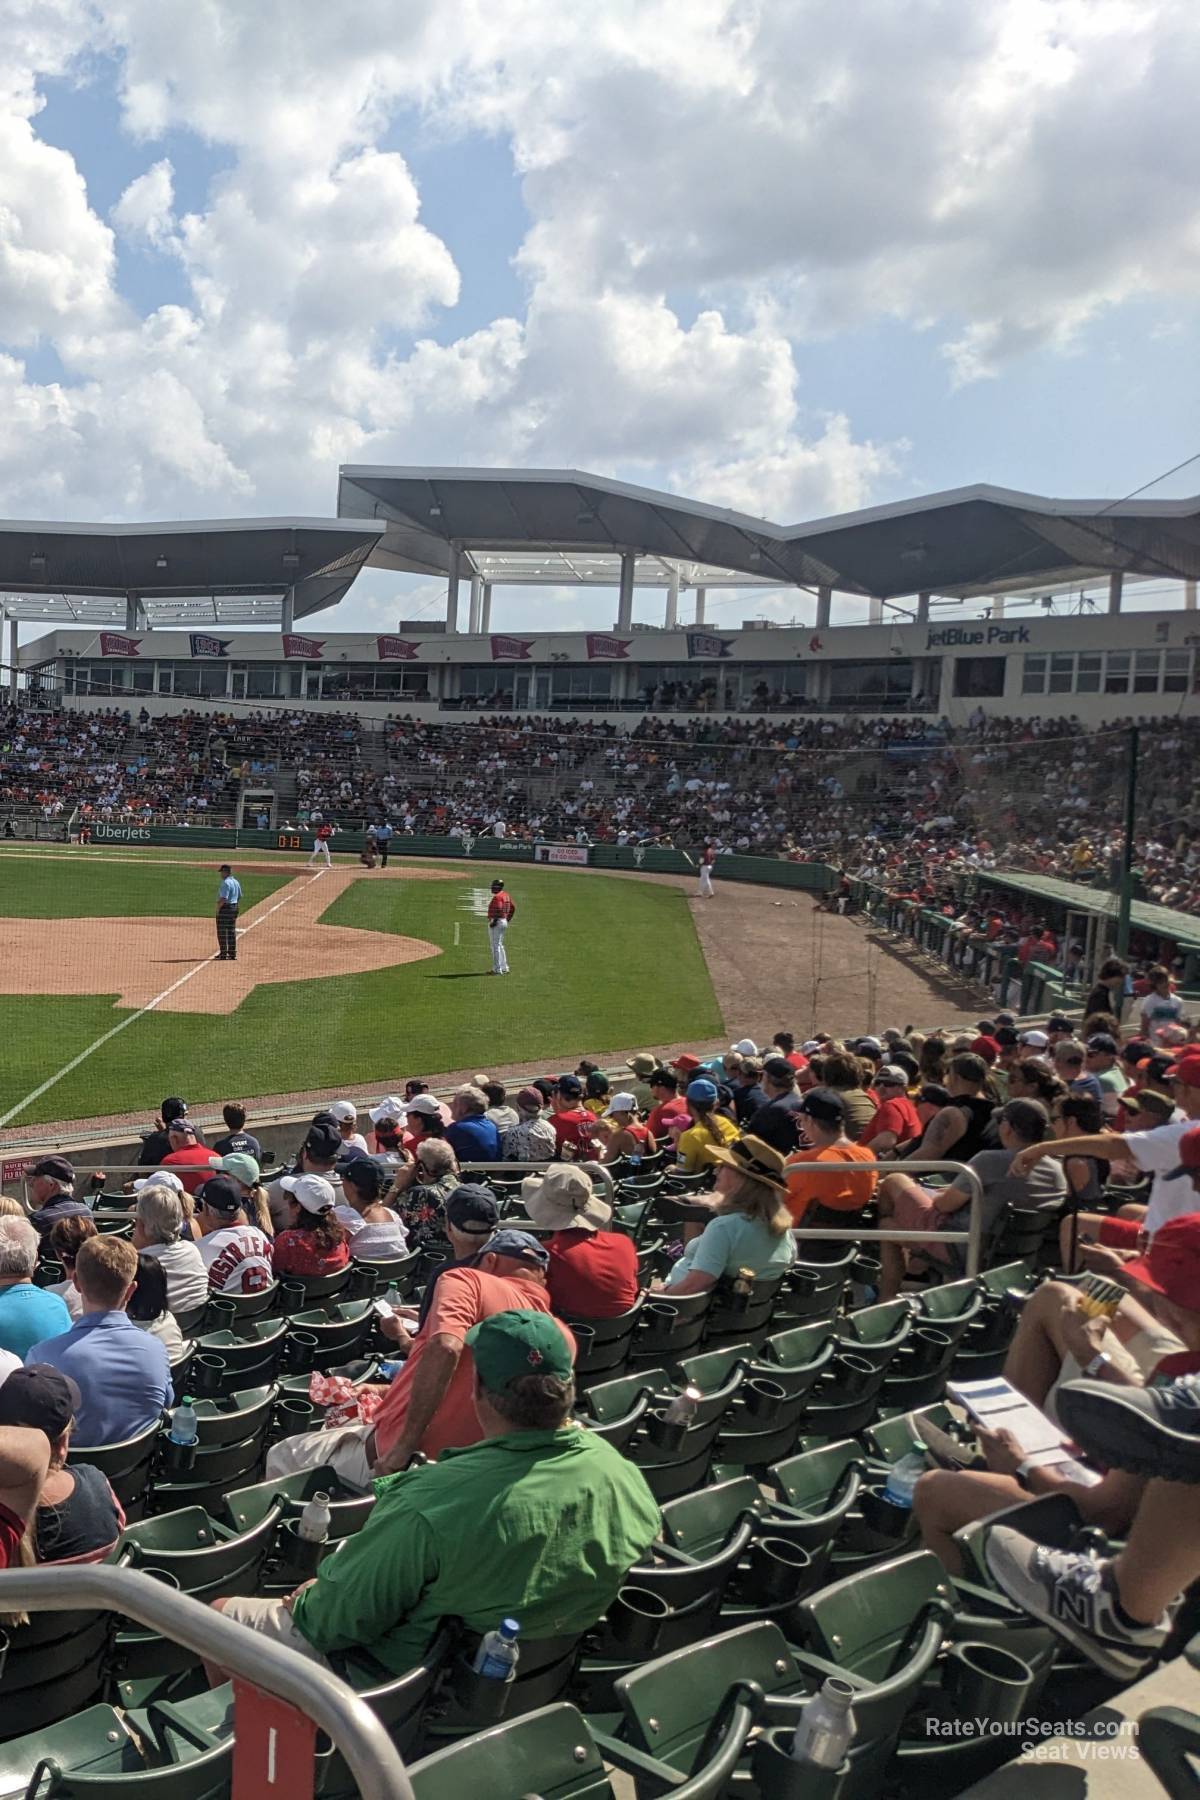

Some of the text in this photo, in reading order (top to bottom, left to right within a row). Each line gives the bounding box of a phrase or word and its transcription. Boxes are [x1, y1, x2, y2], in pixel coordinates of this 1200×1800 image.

[925, 624, 1031, 650] jetBlue Park
[96, 825, 151, 840] UberJets
[4, 1171, 14, 1179] FLY
